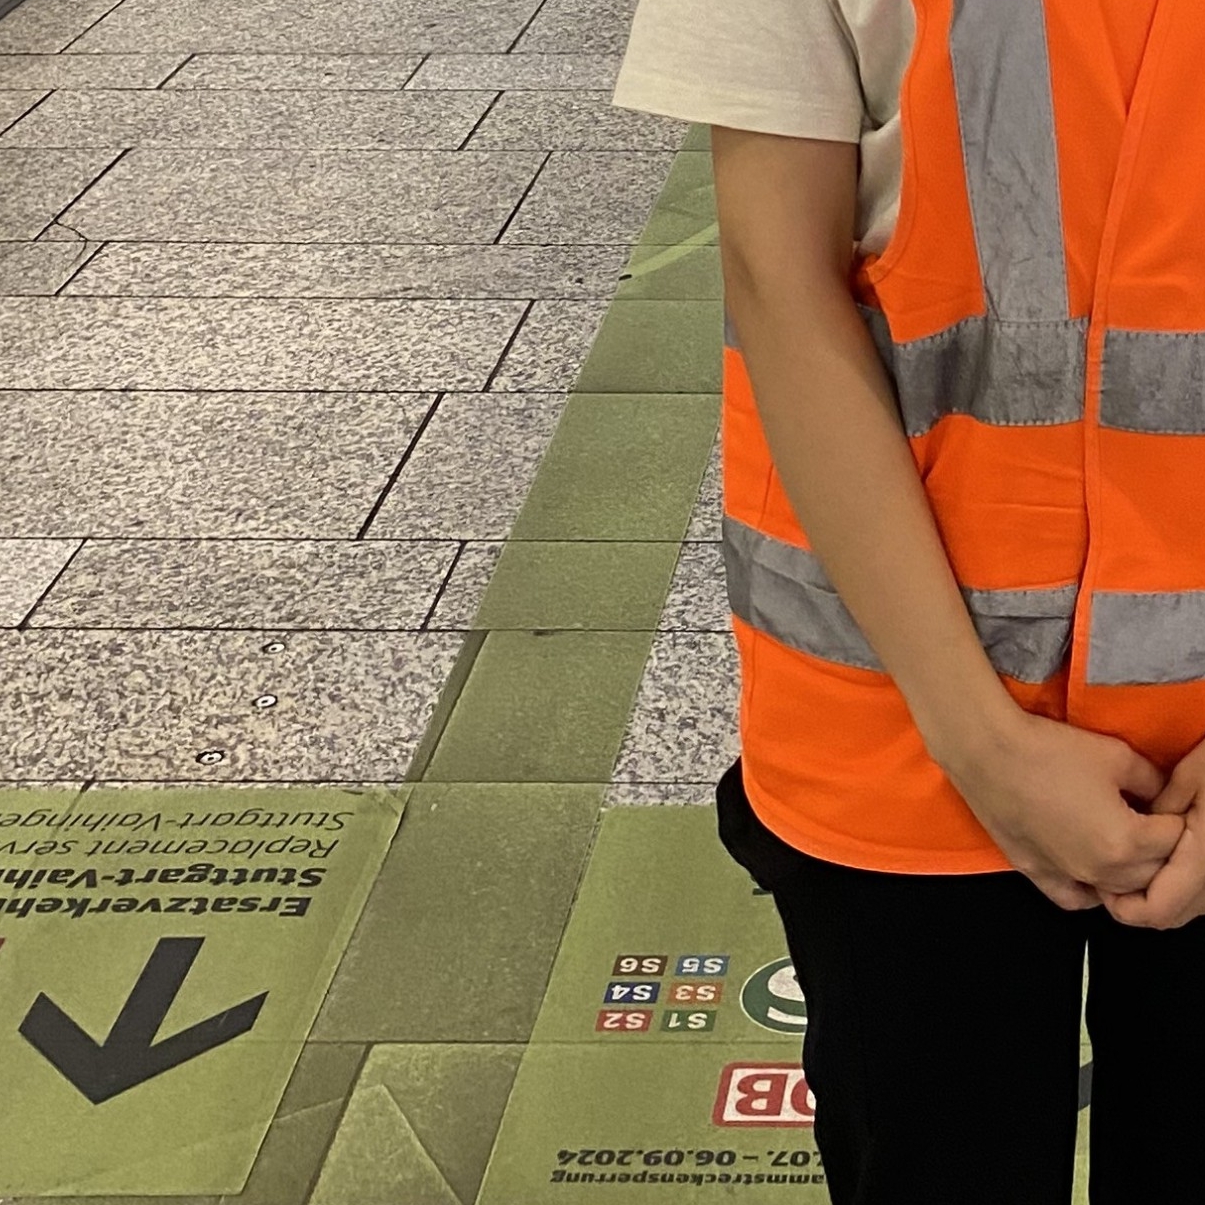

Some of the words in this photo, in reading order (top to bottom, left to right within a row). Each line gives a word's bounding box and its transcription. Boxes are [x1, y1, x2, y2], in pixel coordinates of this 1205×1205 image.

[0, 808, 355, 832] Stuttgart-Vaihinge
[0, 840, 79, 855] serv
[85, 836, 339, 859] Replacement
[620, 958, 661, 973] S6
[683, 958, 723, 973] S5
[611, 985, 653, 1000] S4
[675, 985, 716, 1000] S3
[603, 1013, 645, 1028] S2
[668, 1013, 707, 1028] S1
[558, 1150, 736, 1166] 06.09.2024
